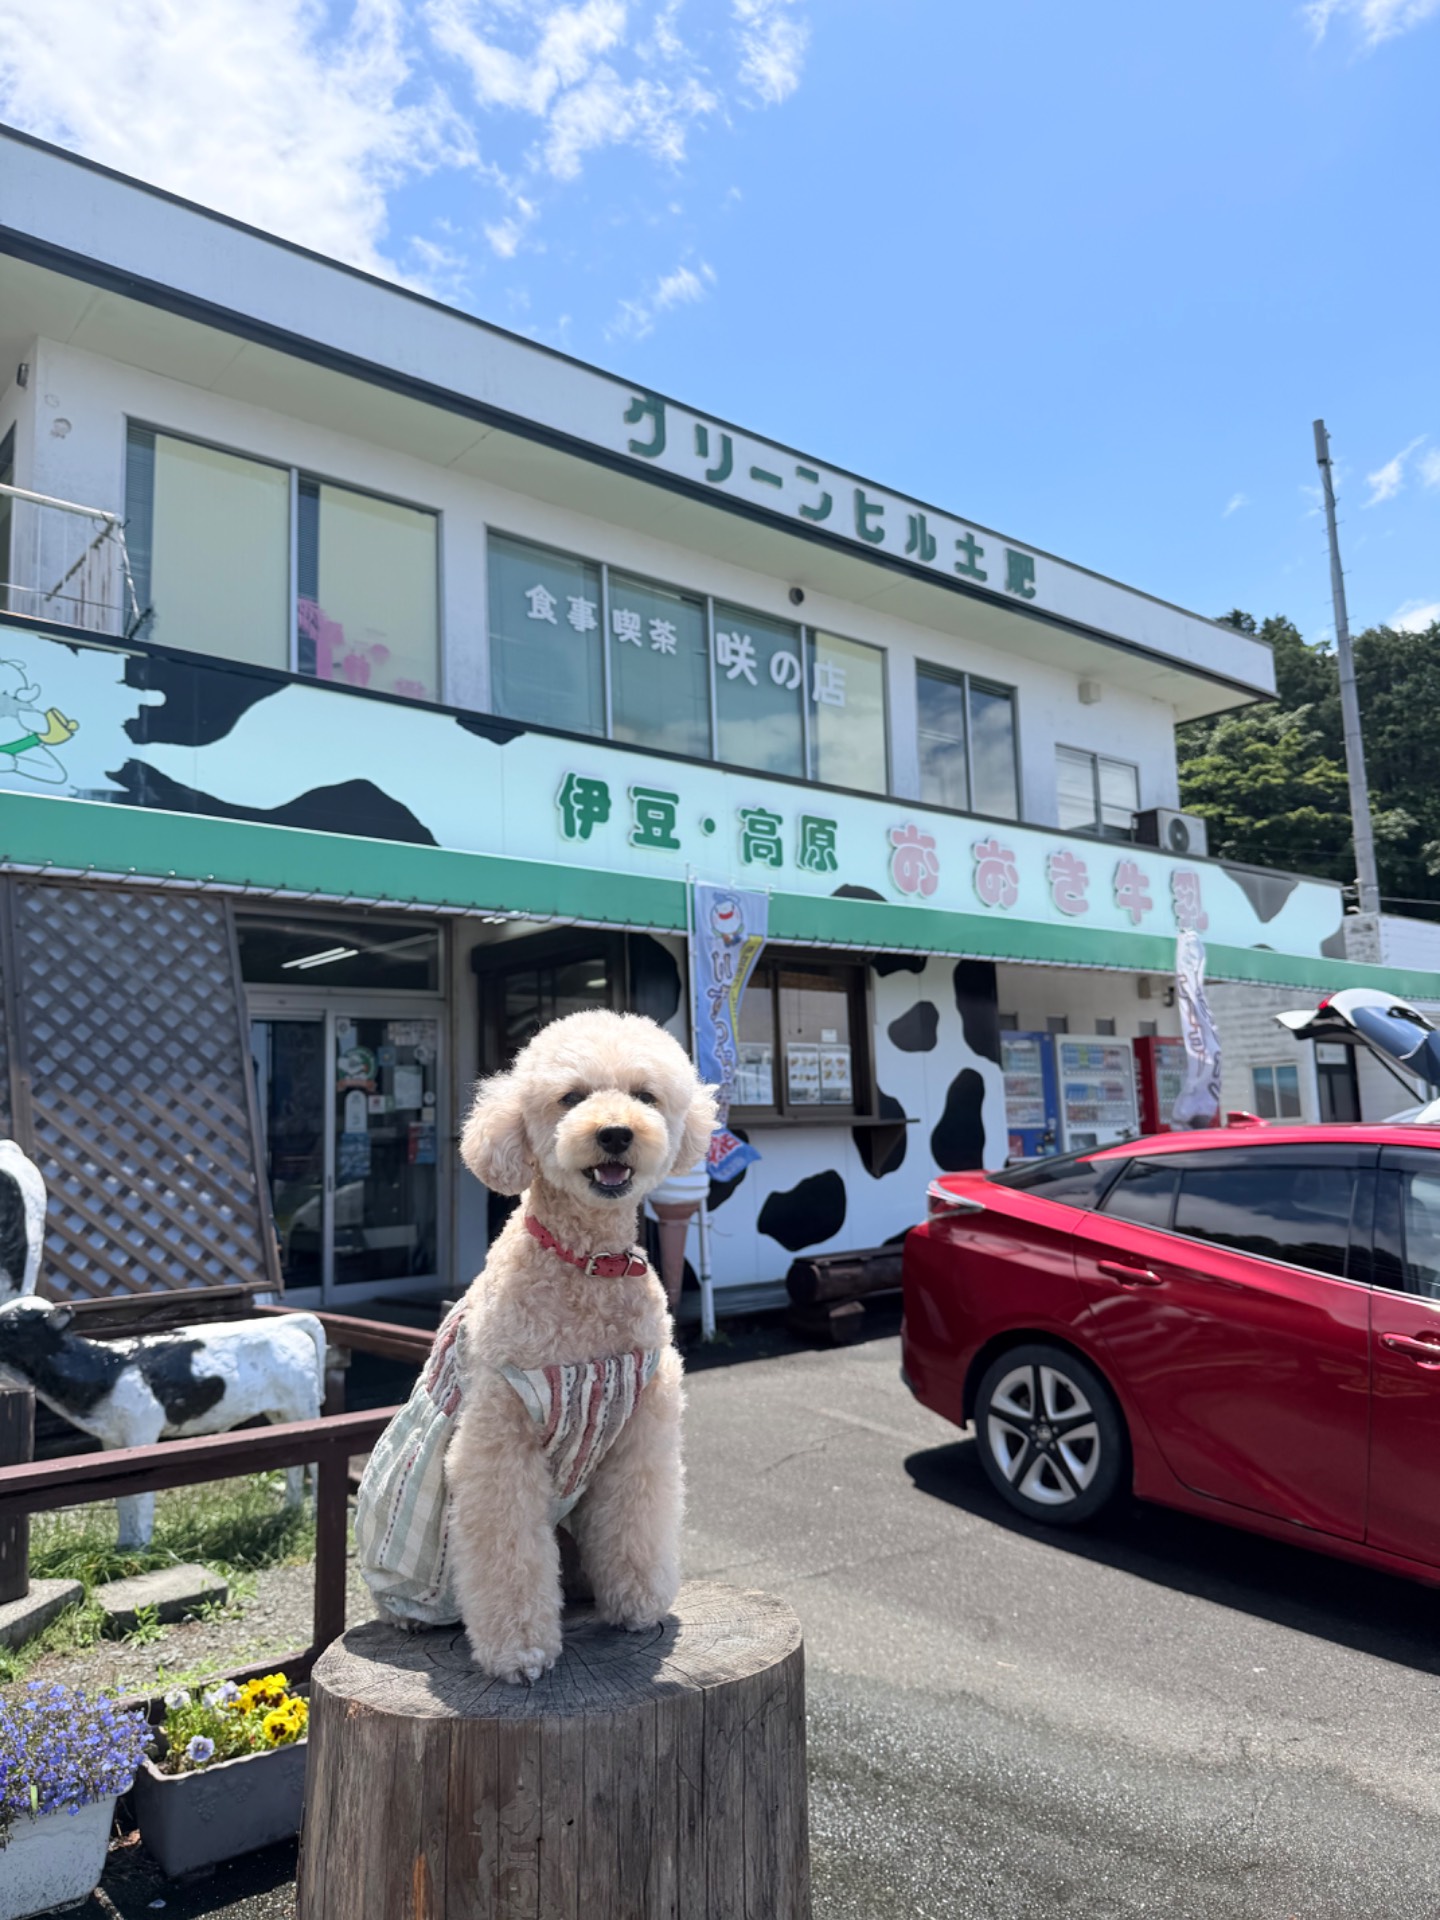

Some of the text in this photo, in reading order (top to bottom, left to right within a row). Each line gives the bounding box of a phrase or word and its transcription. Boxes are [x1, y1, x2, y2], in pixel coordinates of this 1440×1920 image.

[623, 393, 1037, 600] グリーンヒル土肥
[525, 585, 677, 655] 食事 喫茶
[715, 630, 847, 708] 咲の店
[557, 771, 839, 873] 伊豆・高原
